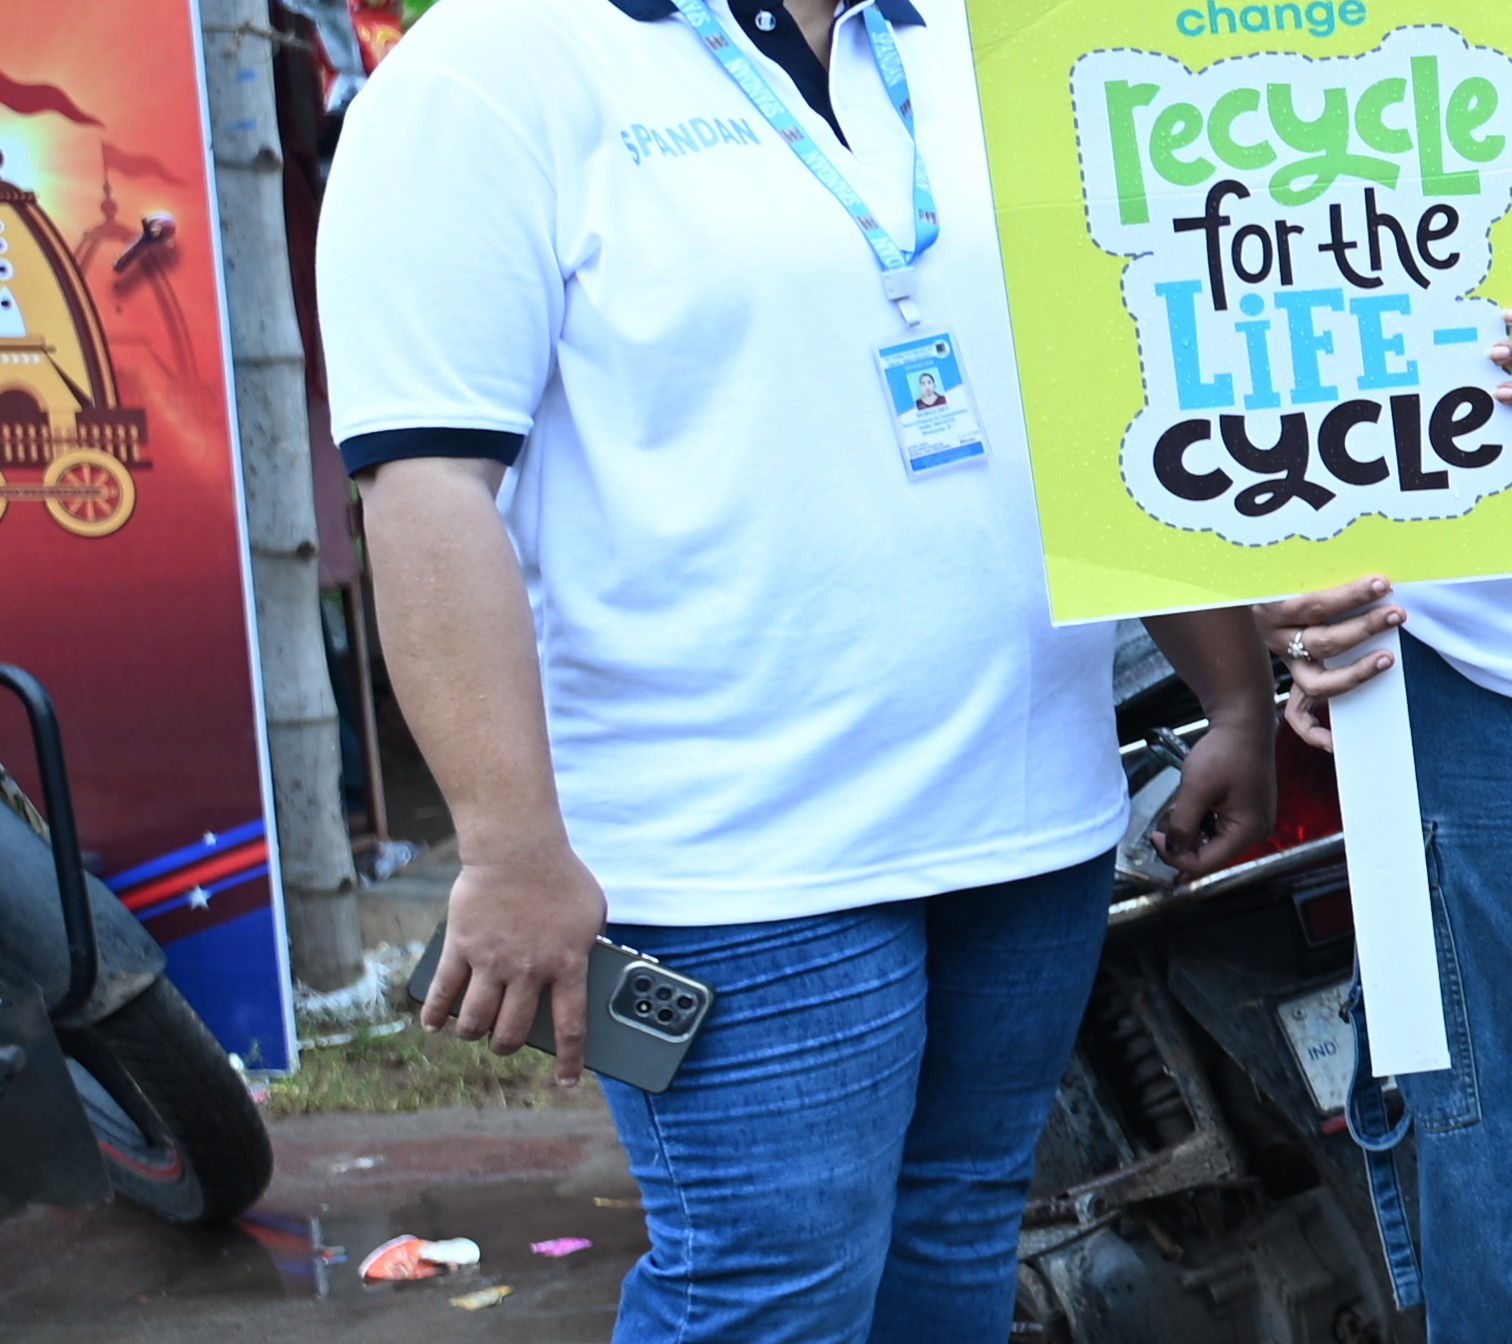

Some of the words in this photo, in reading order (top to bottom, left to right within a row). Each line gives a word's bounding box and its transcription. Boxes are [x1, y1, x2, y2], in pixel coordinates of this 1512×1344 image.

[621, 117, 761, 166] SPANDAN
[1104, 56, 1505, 225] recycle
[1173, 179, 1304, 311] for
[1317, 188, 1461, 290] the
[1152, 386, 1502, 516] cycle
[1307, 1041, 1337, 1060] IND
